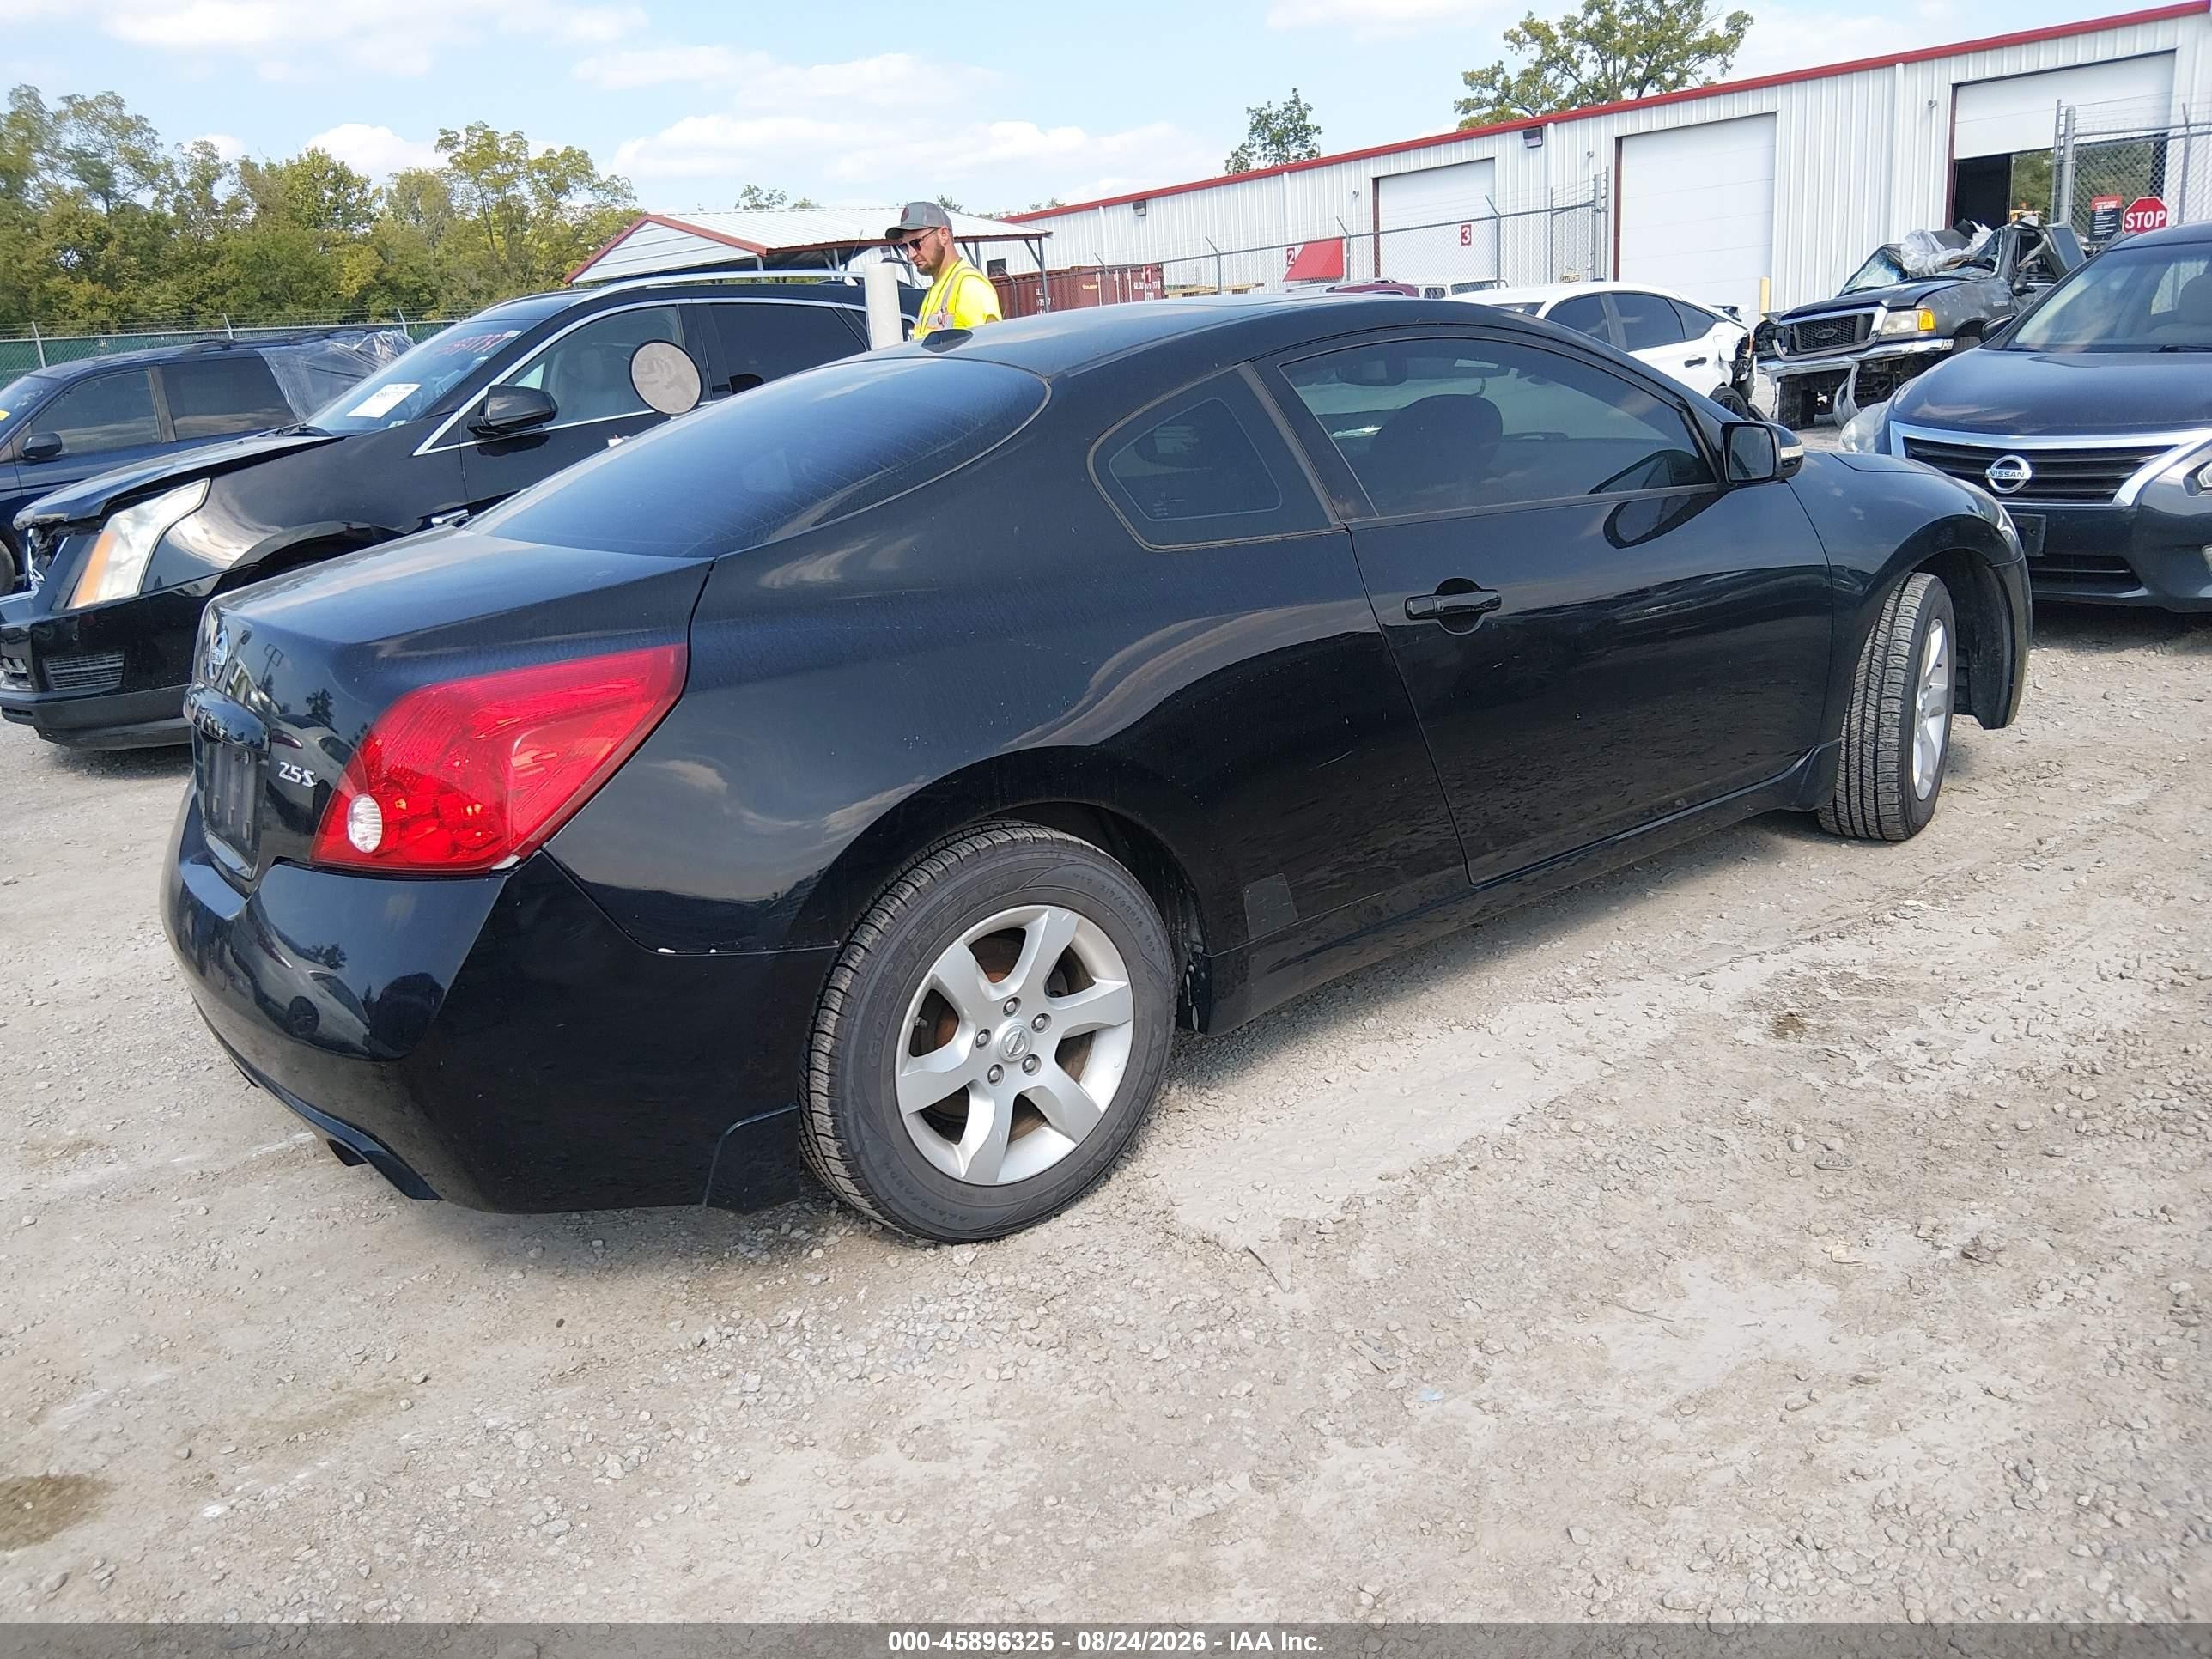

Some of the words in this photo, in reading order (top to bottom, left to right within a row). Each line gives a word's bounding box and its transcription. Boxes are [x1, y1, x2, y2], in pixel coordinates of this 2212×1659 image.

[2125, 210, 2166, 229] STOP
[1462, 227, 1471, 244] 3
[1287, 250, 1295, 265] 2
